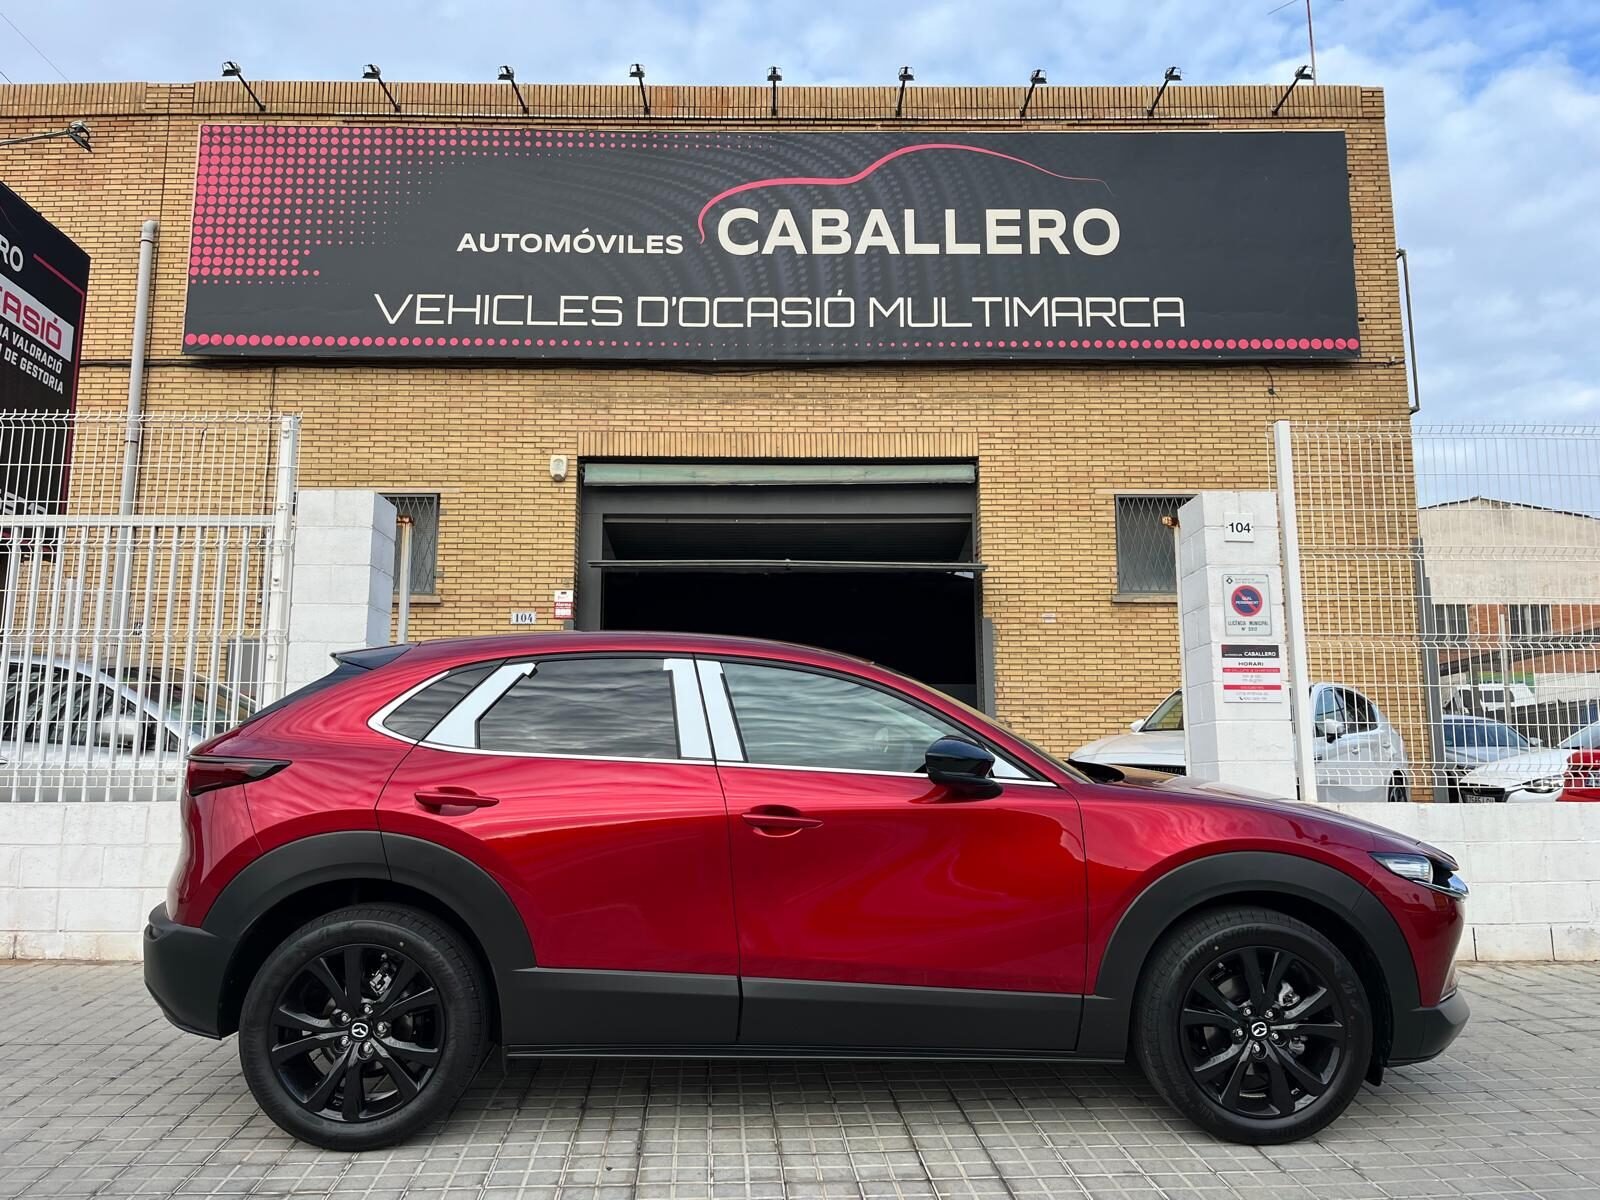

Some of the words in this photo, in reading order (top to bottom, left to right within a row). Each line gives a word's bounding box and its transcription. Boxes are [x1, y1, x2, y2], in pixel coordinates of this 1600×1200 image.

[456, 228, 684, 255] AUTOMÓVILES
[717, 208, 1121, 256] CABALLERO
[0, 286, 62, 351] ASIÓ
[373, 293, 624, 327] VEHICLES
[636, 289, 856, 329] D'OCASIÓ
[868, 296, 1186, 328] MULTIMARCA
[4, 347, 19, 366] DE
[19, 357, 64, 395] GESTORIA
[12, 332, 63, 374] VALORACIÓ
[1228, 522, 1251, 533] 104
[515, 613, 533, 623] 104
